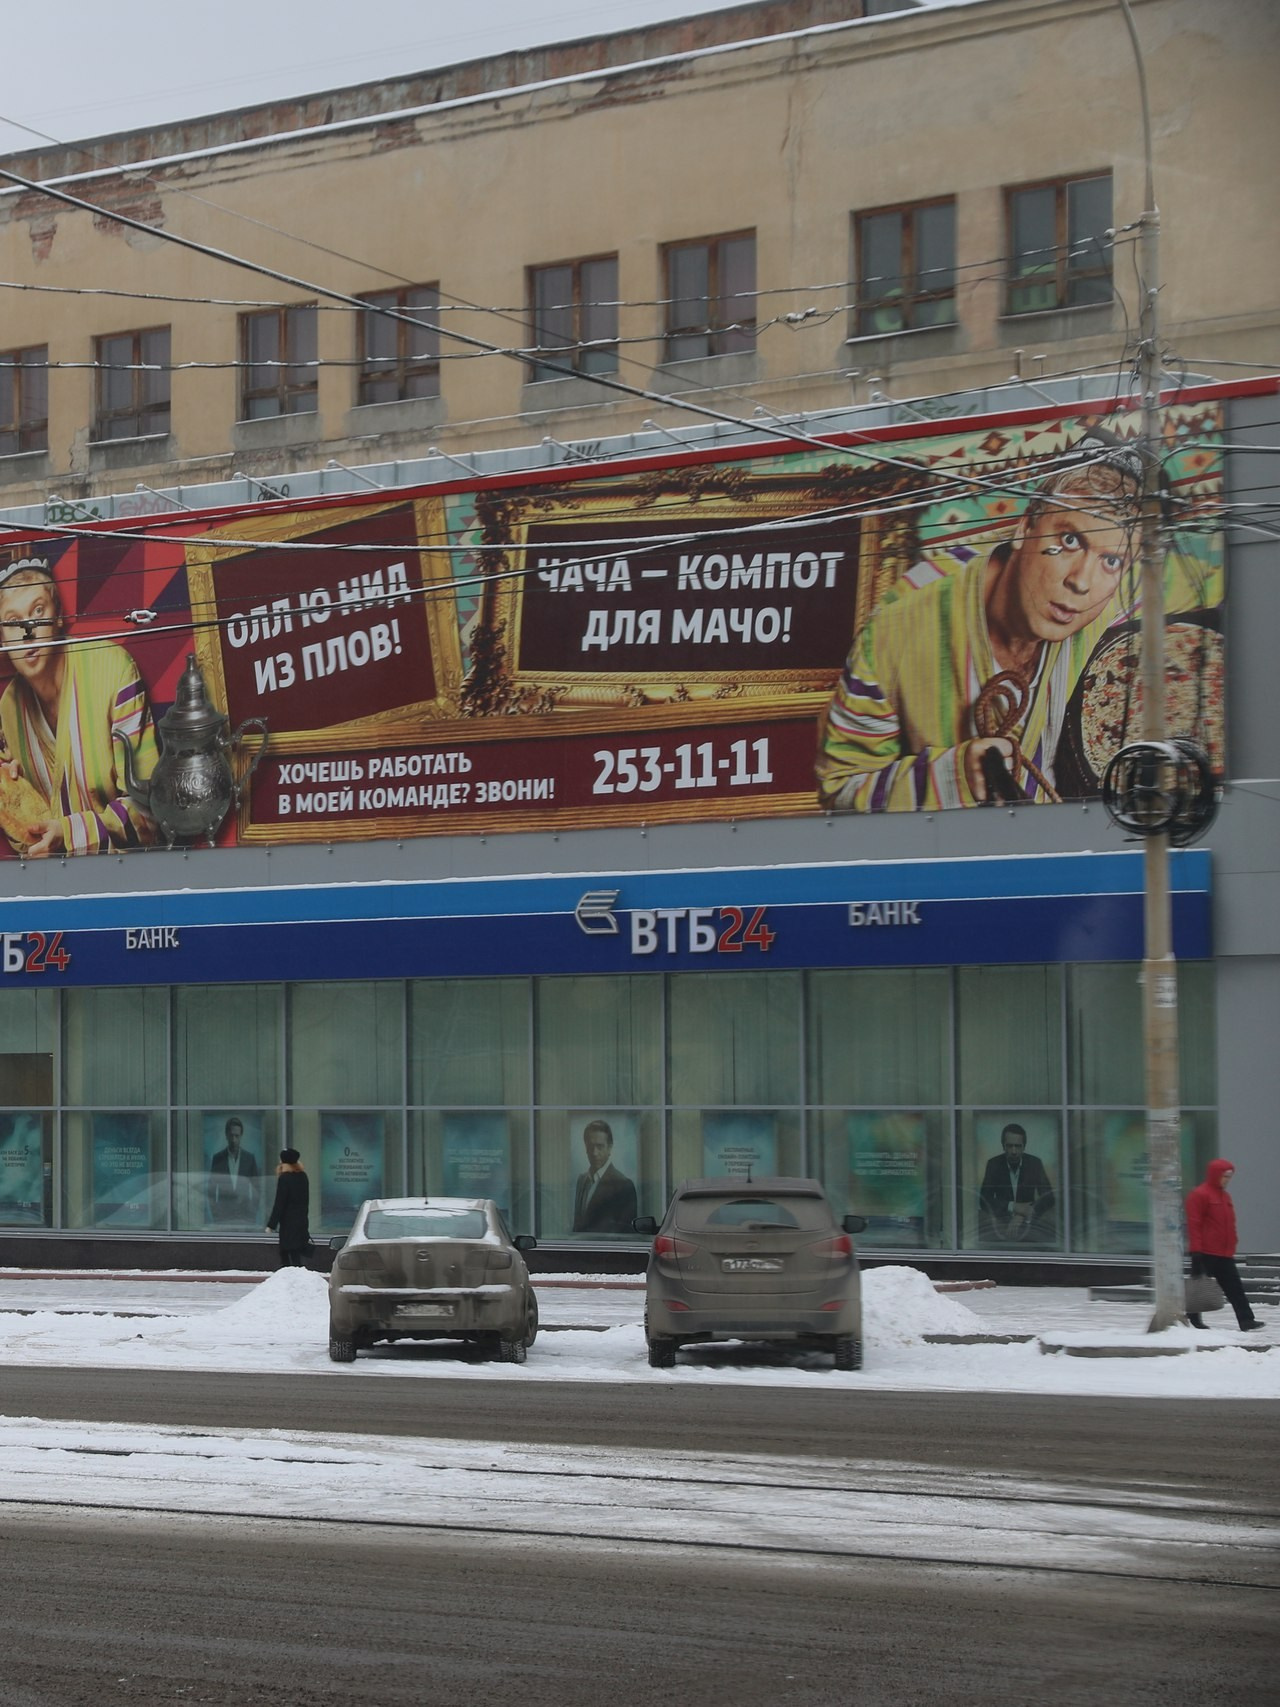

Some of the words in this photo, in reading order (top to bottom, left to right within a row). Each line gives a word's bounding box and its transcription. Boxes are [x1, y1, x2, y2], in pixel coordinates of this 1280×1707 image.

[537, 557, 632, 592] ЧАЧА
[677, 551, 845, 591] КОМПОТ
[227, 598, 293, 648] ОЛЛ
[299, 587, 332, 628] Ю
[338, 561, 411, 616] НИД
[581, 609, 661, 652] ДЛЯ
[671, 607, 792, 644] МАЧО!
[254, 652, 296, 695] ИЗ
[301, 618, 402, 681] ПЛОВ!
[278, 760, 364, 785] ХОЧЕШЬ
[368, 752, 473, 779] РАБОТАТЬ
[592, 737, 773, 796] 253-11-11
[278, 794, 291, 815] В
[295, 786, 354, 814] МОЕЙ
[359, 782, 471, 809] КОМАНДЕ?
[475, 778, 555, 804] ЗВОНИ!
[125, 927, 179, 950] БАНК
[630, 906, 776, 954] ВТБ24
[848, 901, 921, 927] БАНК
